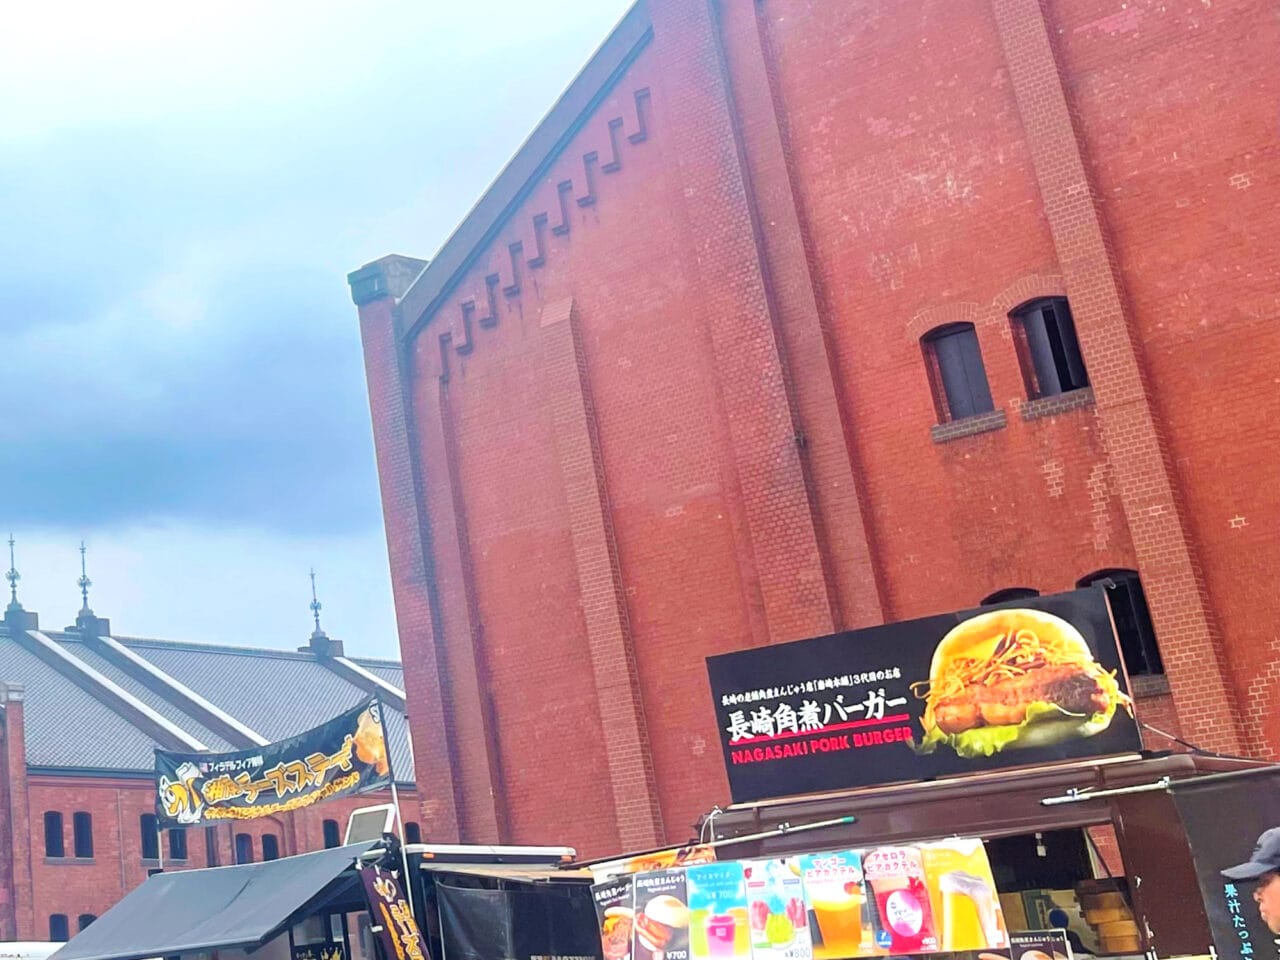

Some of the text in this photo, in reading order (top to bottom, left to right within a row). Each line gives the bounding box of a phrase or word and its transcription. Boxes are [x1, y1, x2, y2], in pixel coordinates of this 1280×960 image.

[726, 688, 907, 742] 長崎角煮バーガー
[731, 726, 913, 765] NAGASAKI PORK BURGER
[873, 850, 907, 861] アセロラ
[806, 866, 856, 878] ビアカクテル
[866, 861, 918, 873] ビアカクテル
